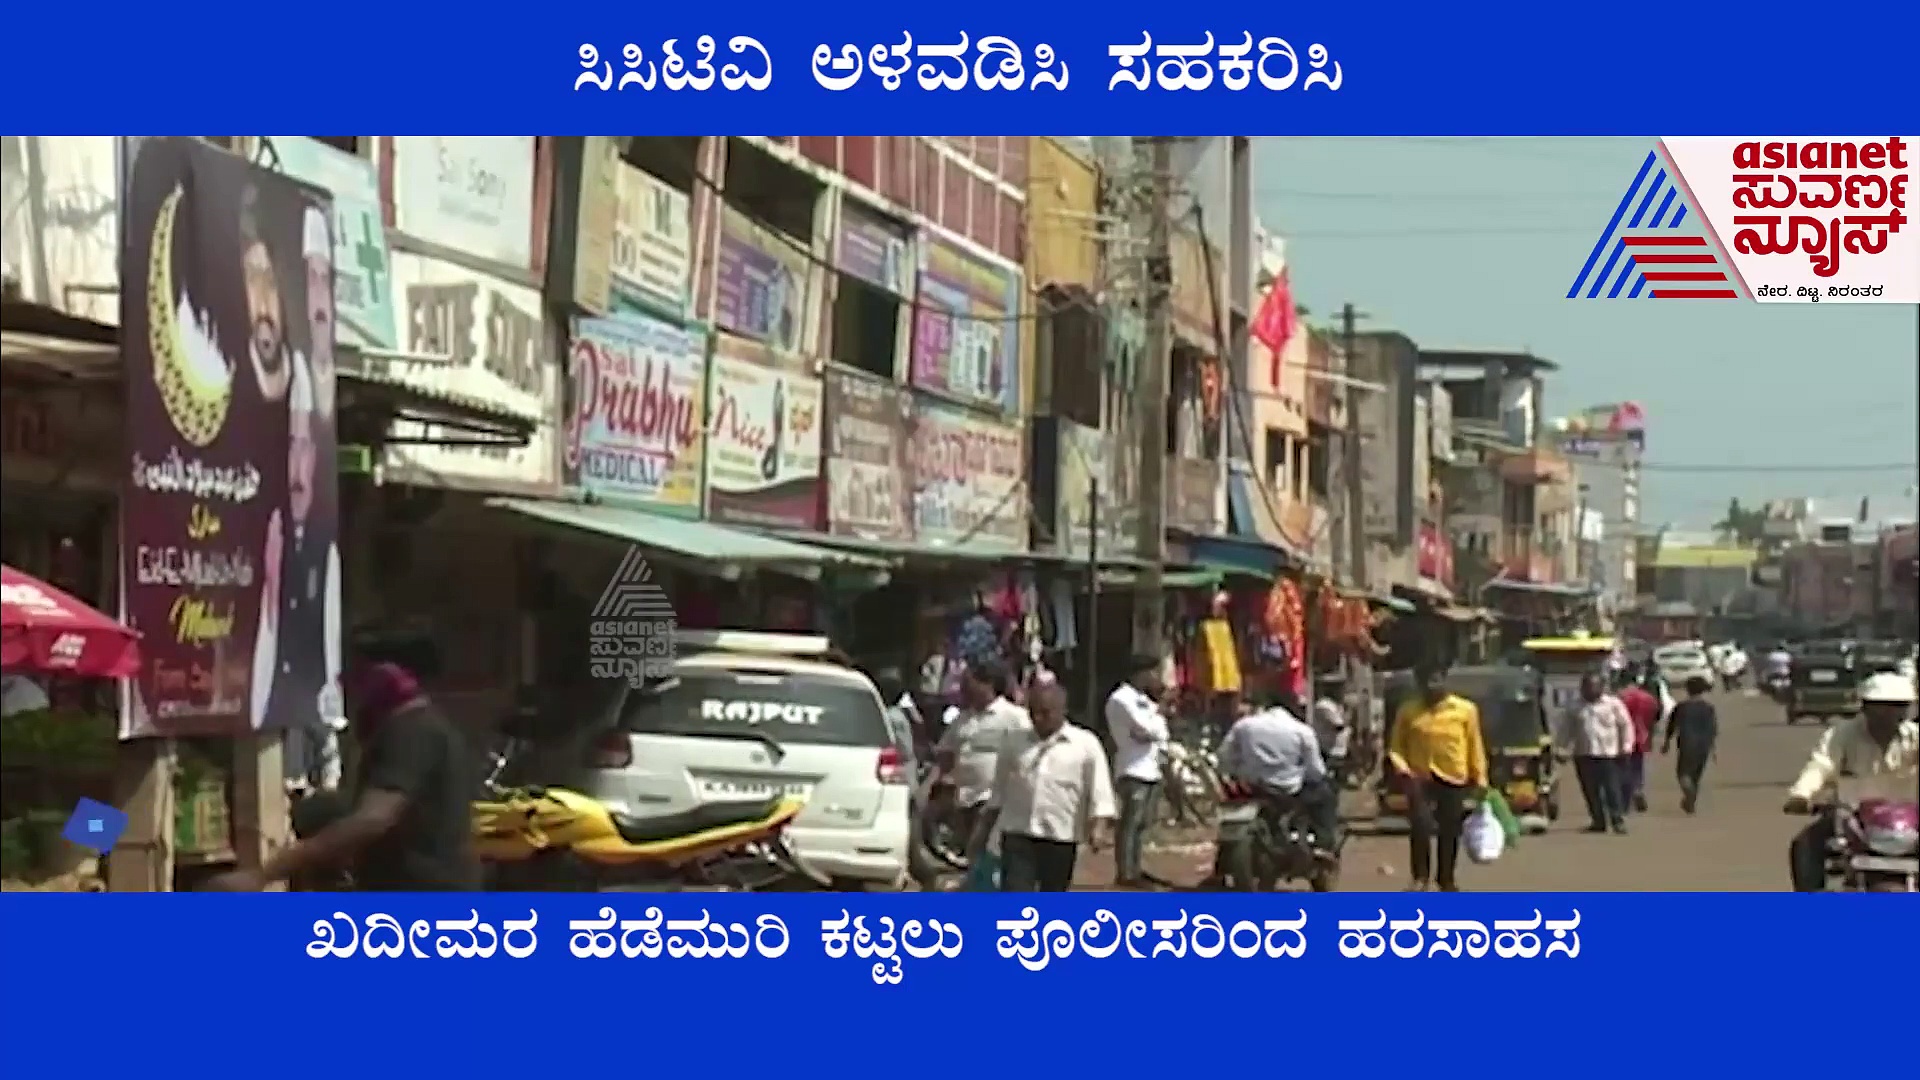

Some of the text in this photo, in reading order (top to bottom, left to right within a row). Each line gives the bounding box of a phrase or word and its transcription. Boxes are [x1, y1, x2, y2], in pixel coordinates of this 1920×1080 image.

[568, 338, 697, 470] Prabhu
[582, 448, 660, 487] MEDICAL
[701, 699, 826, 725] RAJPUT
